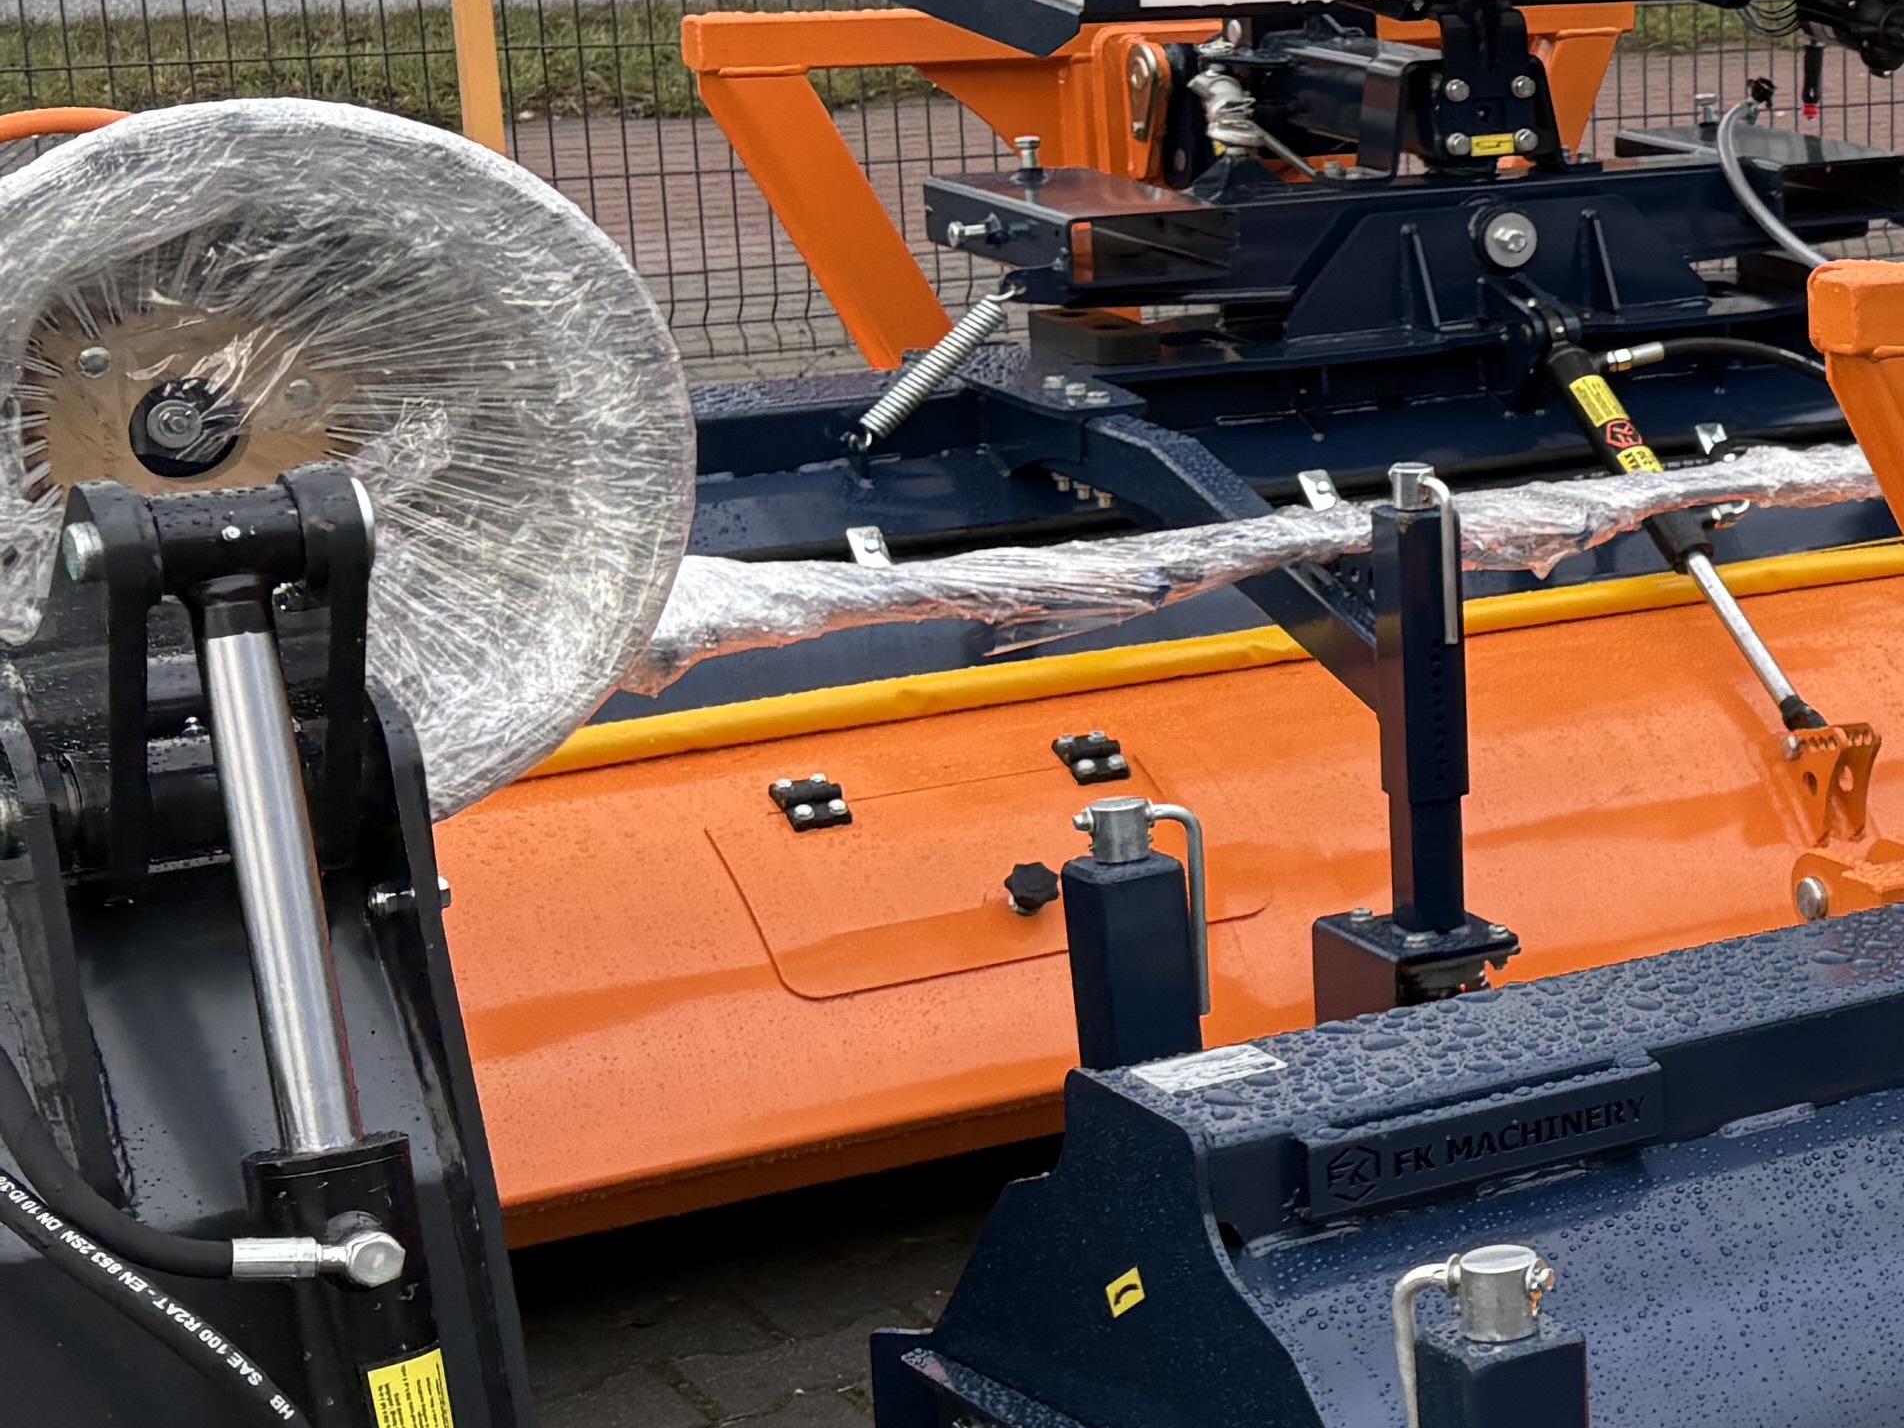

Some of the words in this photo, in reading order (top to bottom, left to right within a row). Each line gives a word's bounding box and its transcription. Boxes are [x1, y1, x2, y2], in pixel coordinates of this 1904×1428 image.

[1393, 1144, 1436, 1179] FK
[1445, 1096, 1646, 1166] MACHINERY
[36, 1212, 63, 1231] DN
[117, 1271, 149, 1293] EN
[152, 1297, 201, 1333] R2AT
[198, 1328, 228, 1355] 100
[226, 1351, 263, 1386] SAE
[269, 1394, 295, 1420] HB
